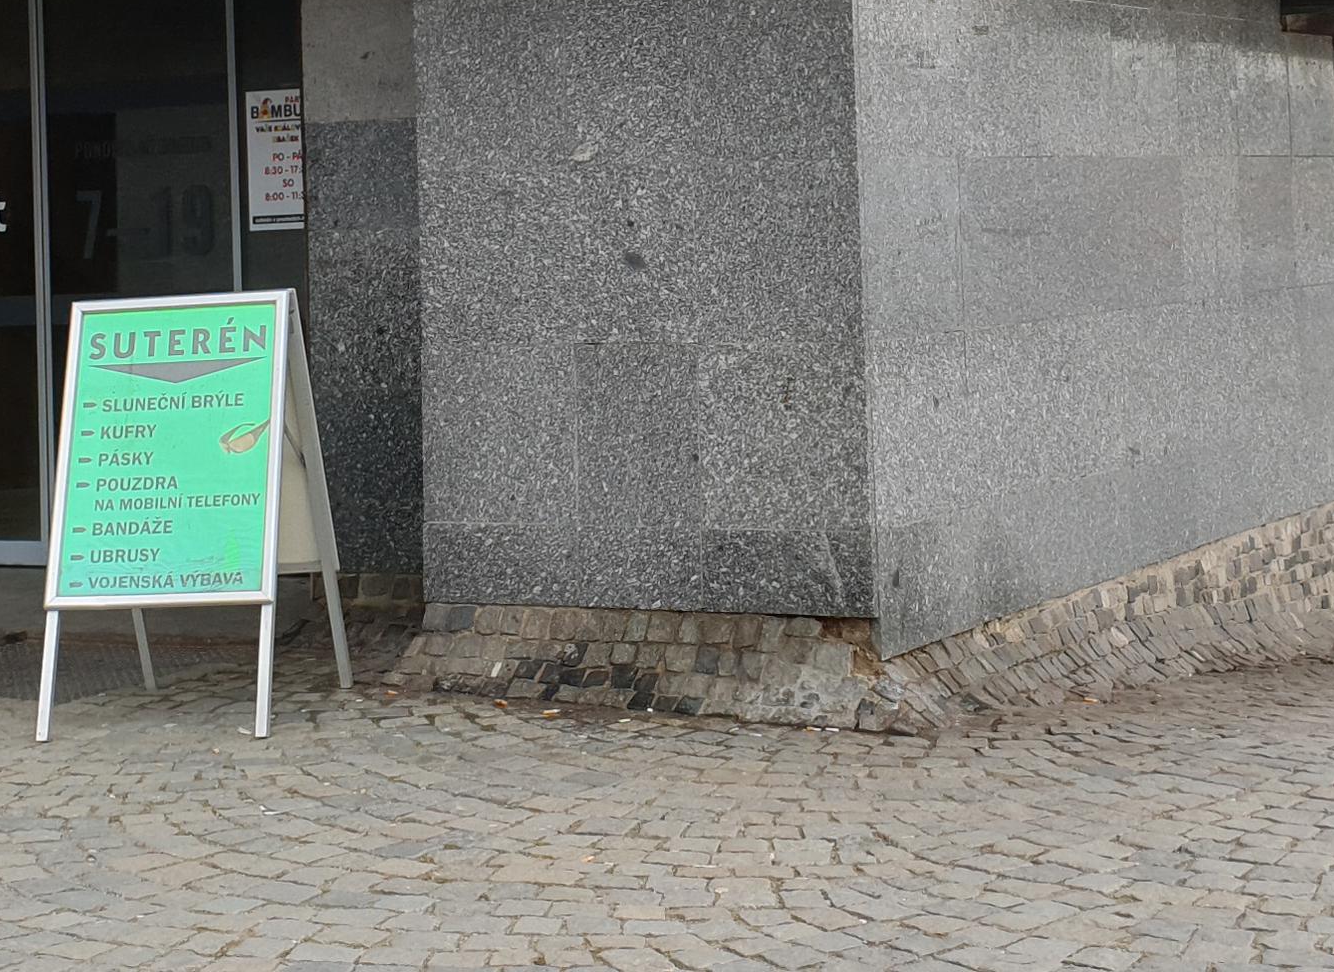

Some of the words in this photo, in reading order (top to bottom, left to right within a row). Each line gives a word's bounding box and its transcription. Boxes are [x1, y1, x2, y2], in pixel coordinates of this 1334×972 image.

[285, 95, 300, 103] PAR
[272, 152, 284, 162] PO
[264, 166, 283, 176] 8:30
[283, 178, 294, 188] SO
[265, 192, 284, 202] 8:00
[89, 317, 267, 360] SUTERÉN
[102, 391, 187, 413] SLUNEČNÍ
[191, 390, 244, 409] BRÝLE
[100, 424, 157, 439] KUFRY
[98, 449, 154, 467] PÁSKY
[96, 476, 178, 492] POUZDRA
[94, 499, 114, 512] NA
[119, 493, 183, 511] MOBILNÍ
[187, 493, 261, 508] TELEFONY
[91, 516, 173, 536] BANDÁŽE
[90, 548, 160, 564] UBRUSY
[88, 571, 175, 589] VOJENSKÁ
[179, 570, 244, 588] VÝBAVA
